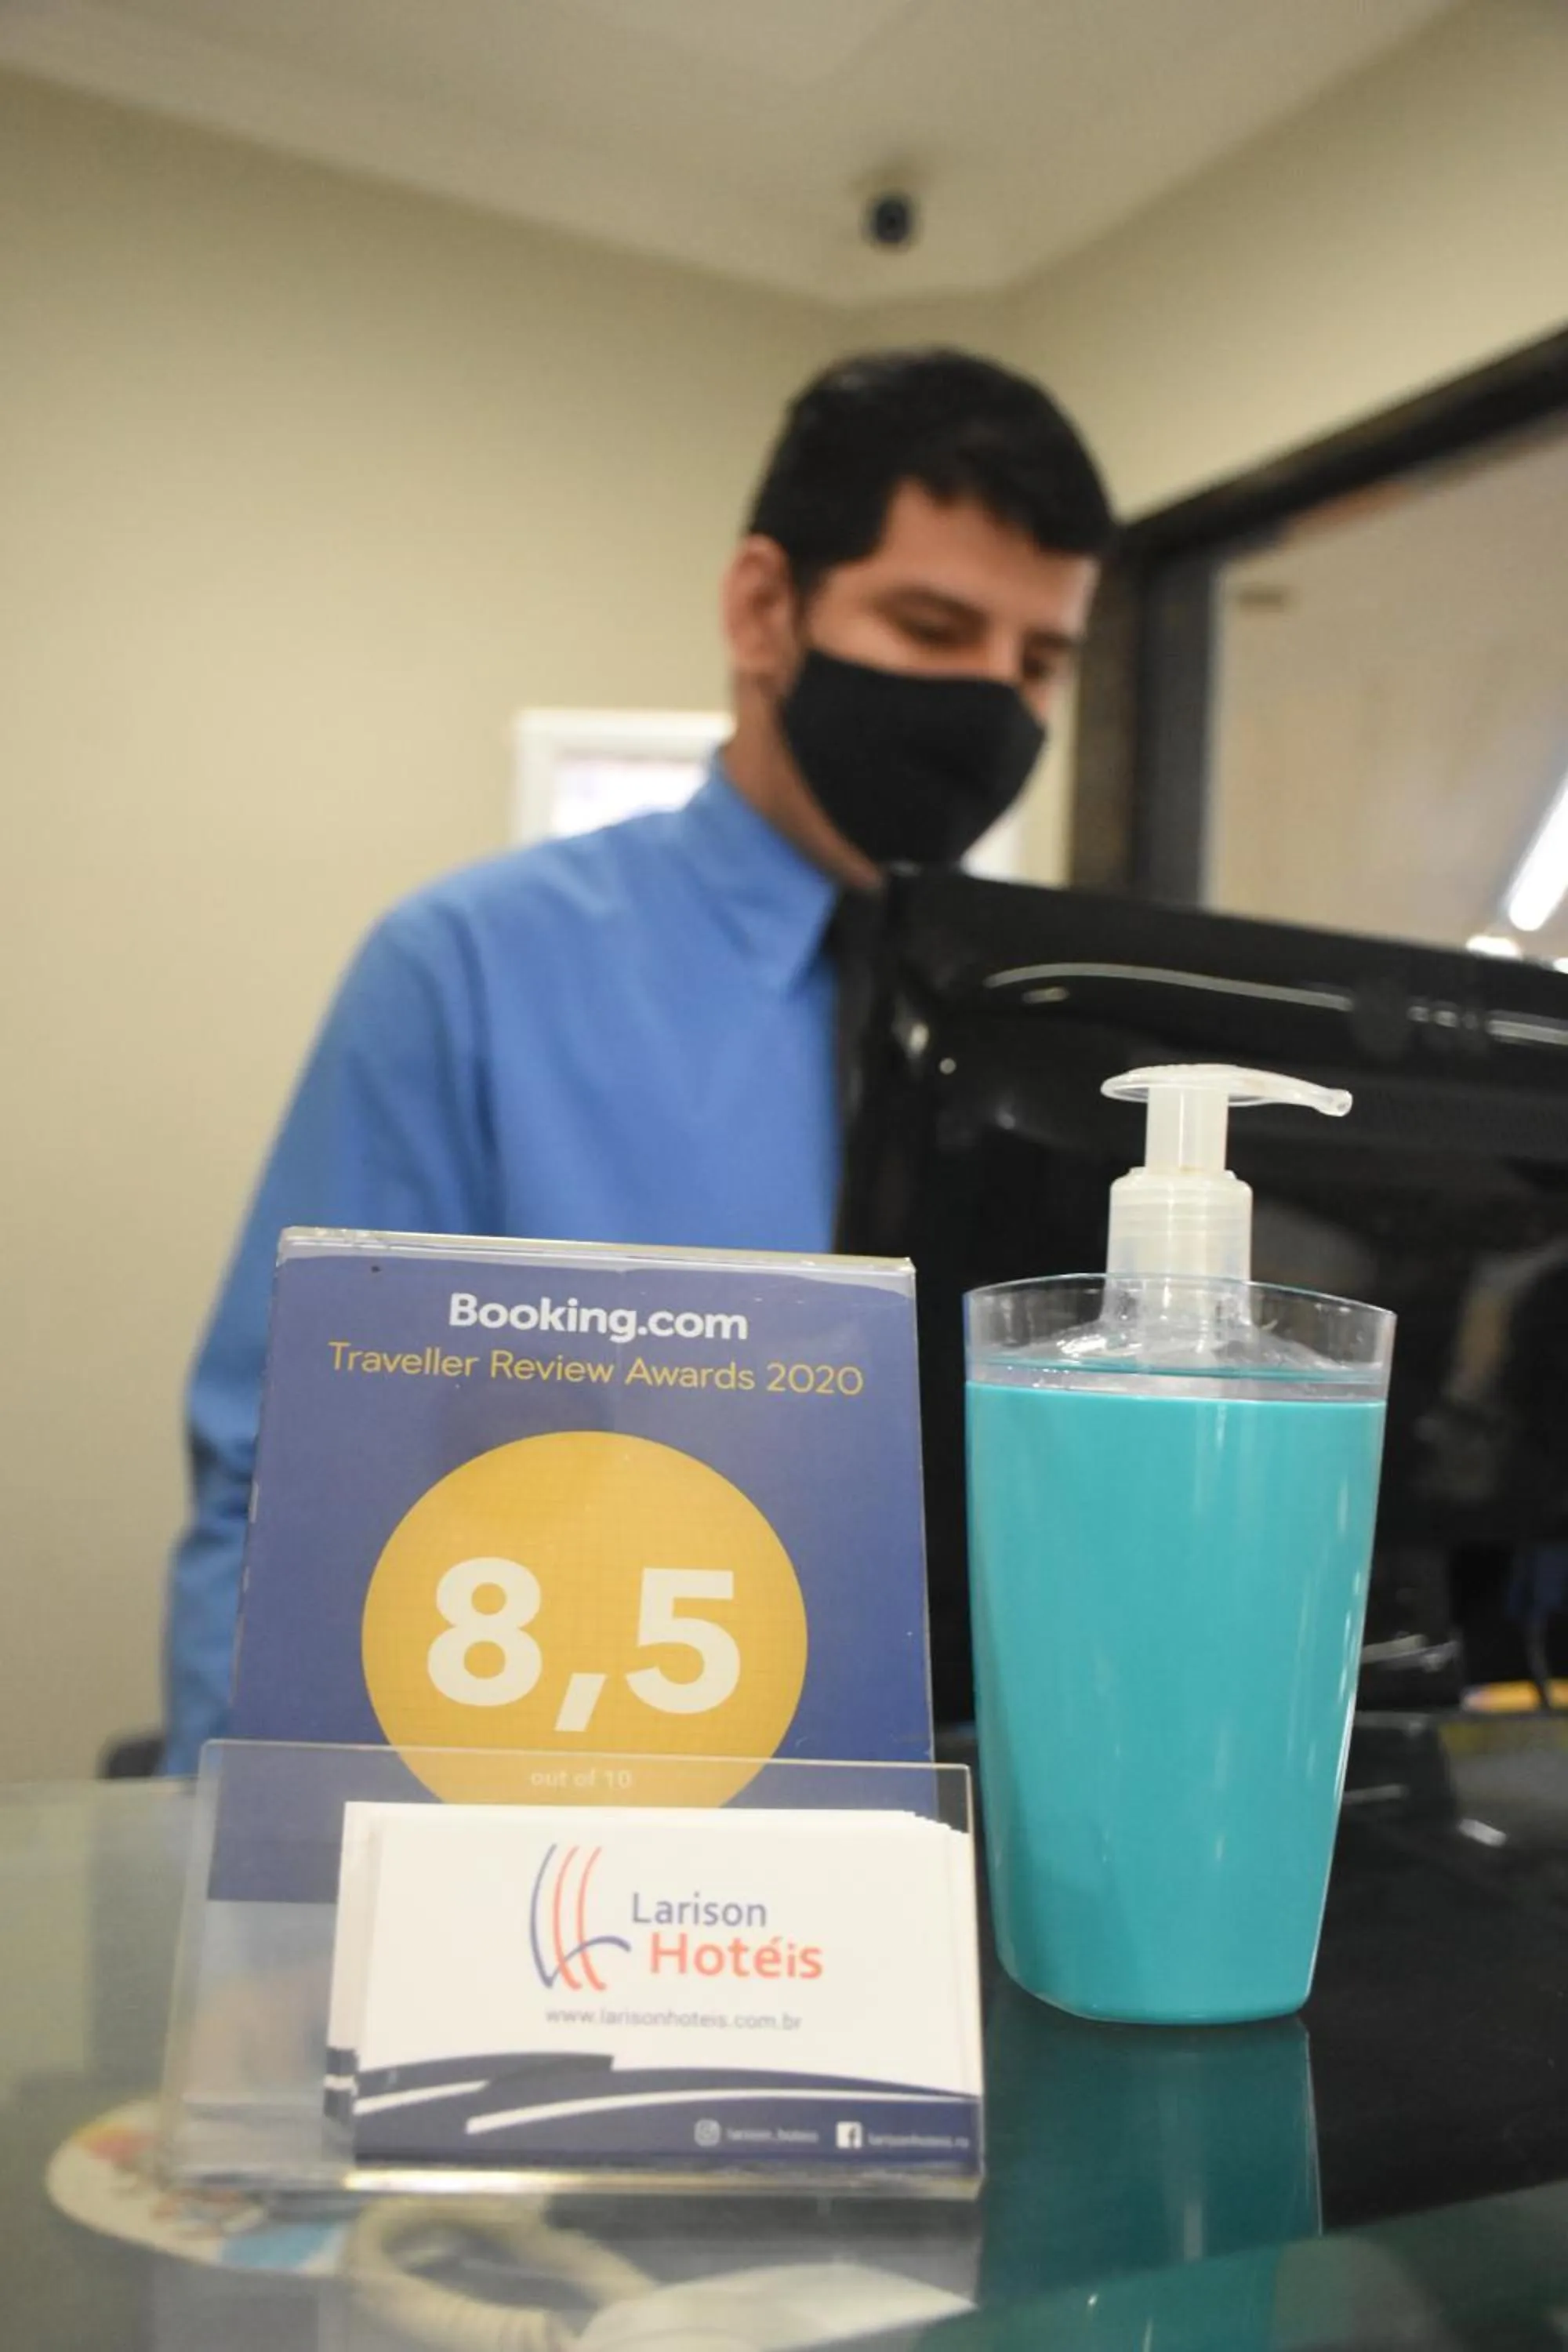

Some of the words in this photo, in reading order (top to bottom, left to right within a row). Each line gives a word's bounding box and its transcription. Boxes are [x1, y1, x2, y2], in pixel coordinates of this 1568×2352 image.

[448, 1292, 748, 1343] Booking.com
[328, 1341, 478, 1377] Traveller
[491, 1350, 614, 1385] Review
[625, 1358, 755, 1391] Awards
[767, 1363, 864, 1396] 2020
[426, 1556, 741, 1732] 8,5
[530, 1770, 566, 1788] out
[572, 1768, 598, 1788] of
[605, 1769, 633, 1789] 10
[633, 1891, 767, 1928] Larison
[650, 1933, 823, 1979] Hotéis
[545, 2007, 803, 2031] www.larisonhoteis.com.br
